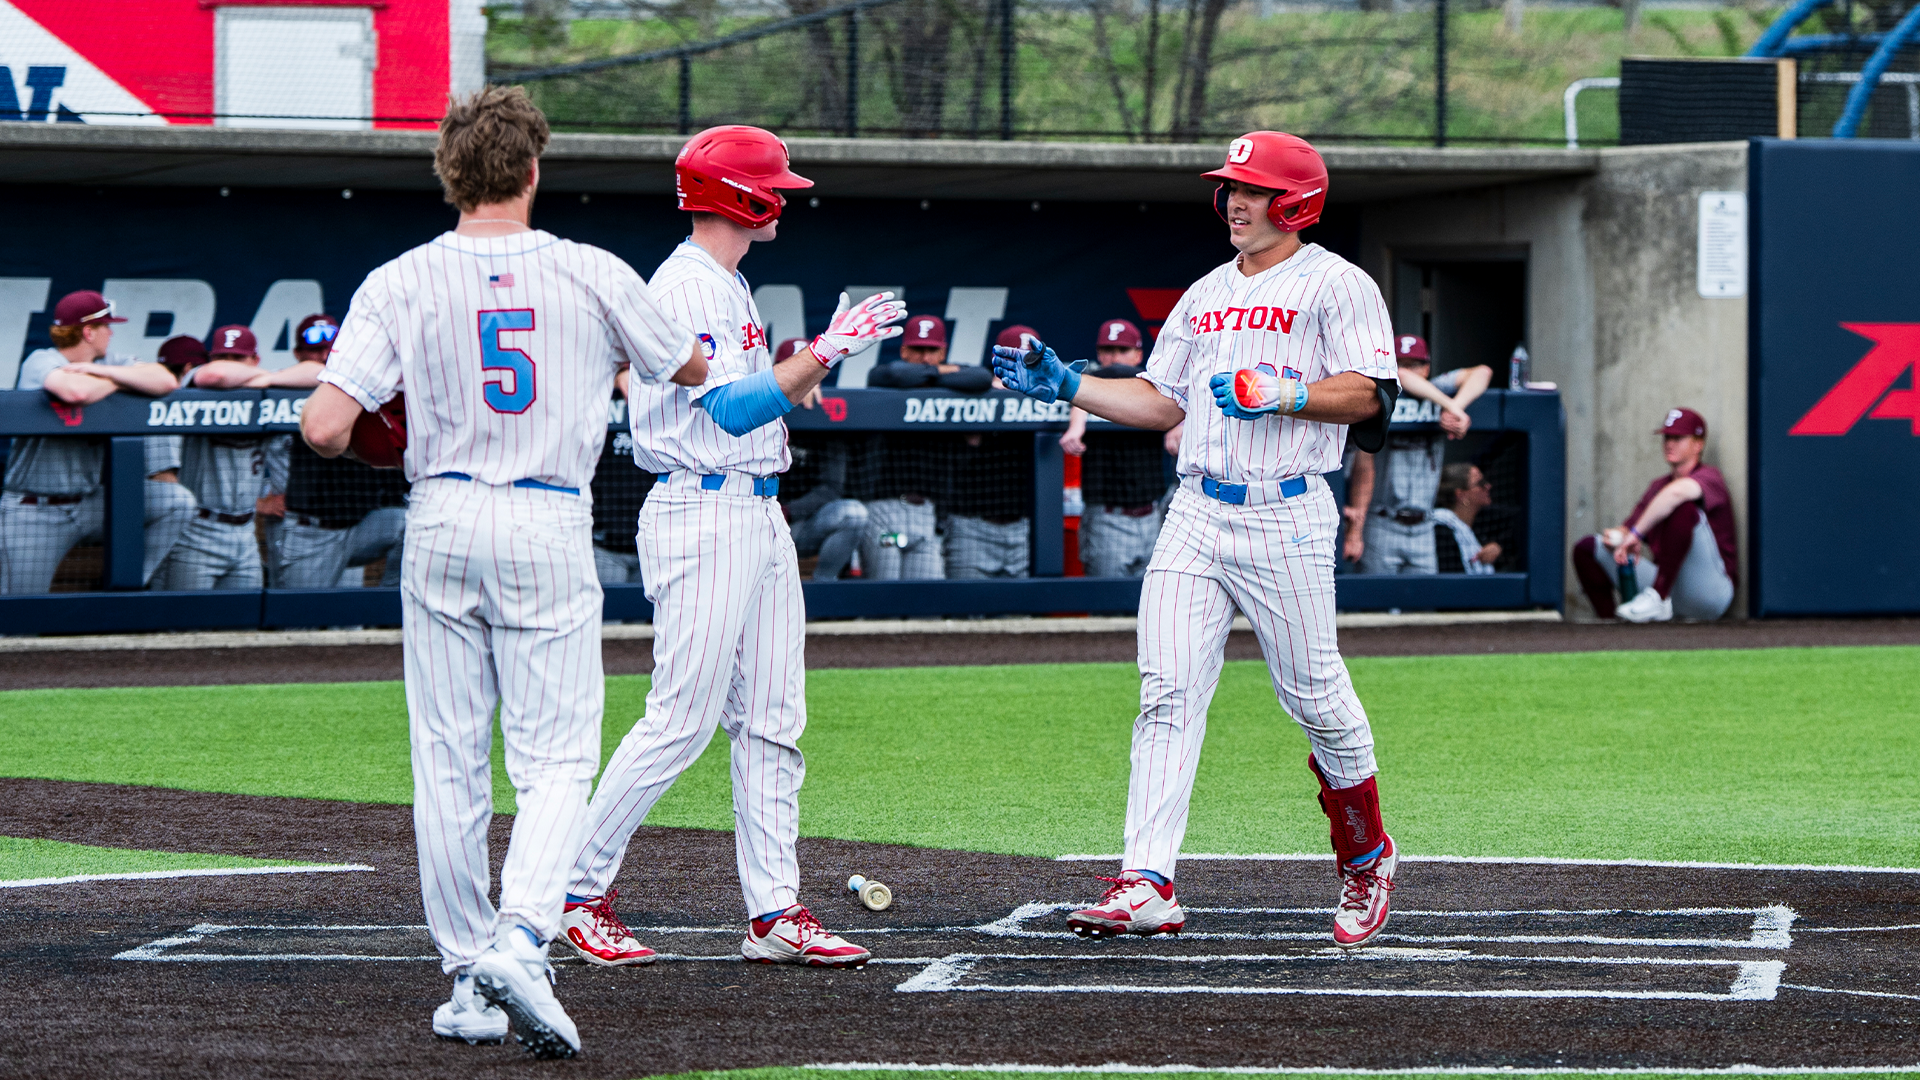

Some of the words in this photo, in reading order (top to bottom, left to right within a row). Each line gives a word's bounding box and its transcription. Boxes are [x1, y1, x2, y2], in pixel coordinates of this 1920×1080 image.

[477, 308, 536, 414] 5
[148, 401, 253, 426] DAYTON
[903, 398, 999, 422] DAYTON
